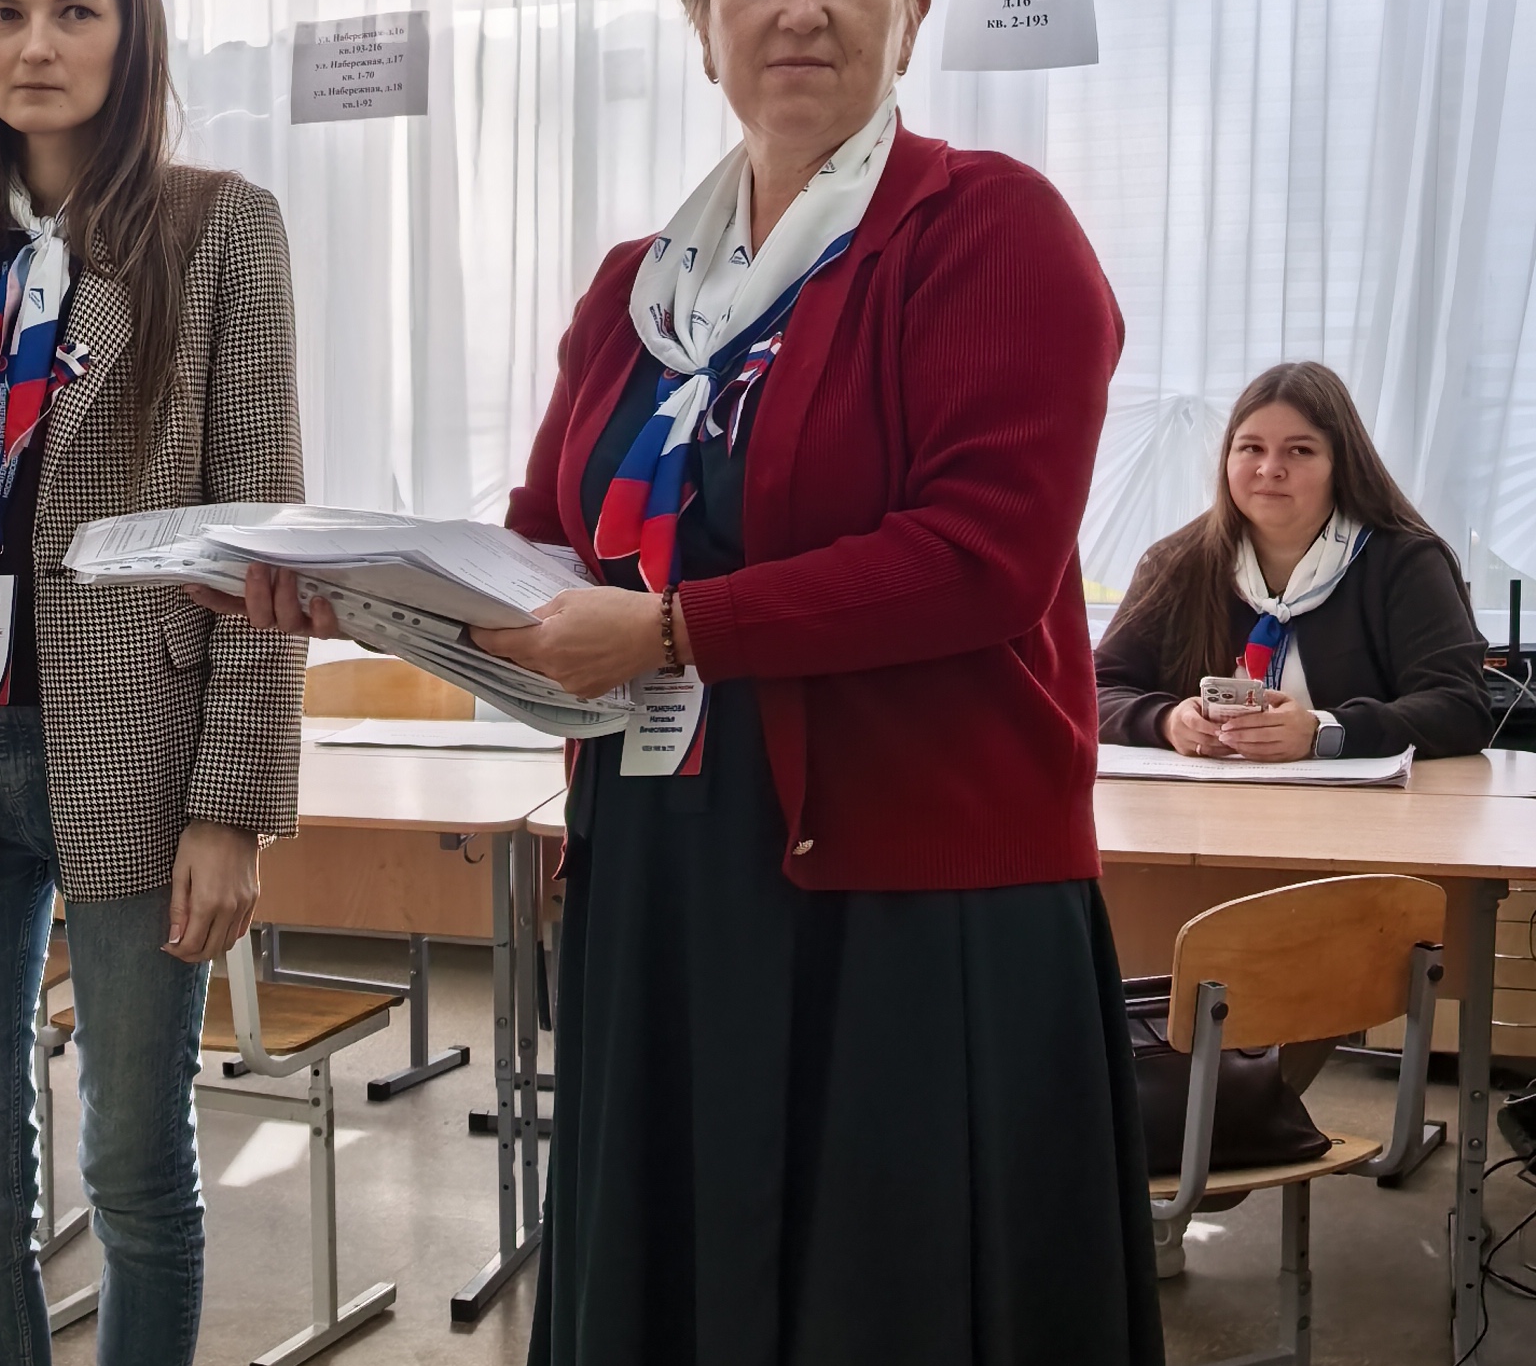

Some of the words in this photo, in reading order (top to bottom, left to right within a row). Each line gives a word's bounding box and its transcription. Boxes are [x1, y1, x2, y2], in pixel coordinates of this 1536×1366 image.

[987, 19, 1007, 29] кв.
[1011, 14, 1049, 29] 2-193
[339, 42, 383, 56] кв.193-216
[330, 57, 385, 70] Набережная,
[386, 54, 404, 66] д.17
[357, 70, 375, 80] 1-70
[328, 85, 383, 98] Набережная,
[385, 82, 403, 93] д.18
[342, 98, 373, 110] кв.1-92
